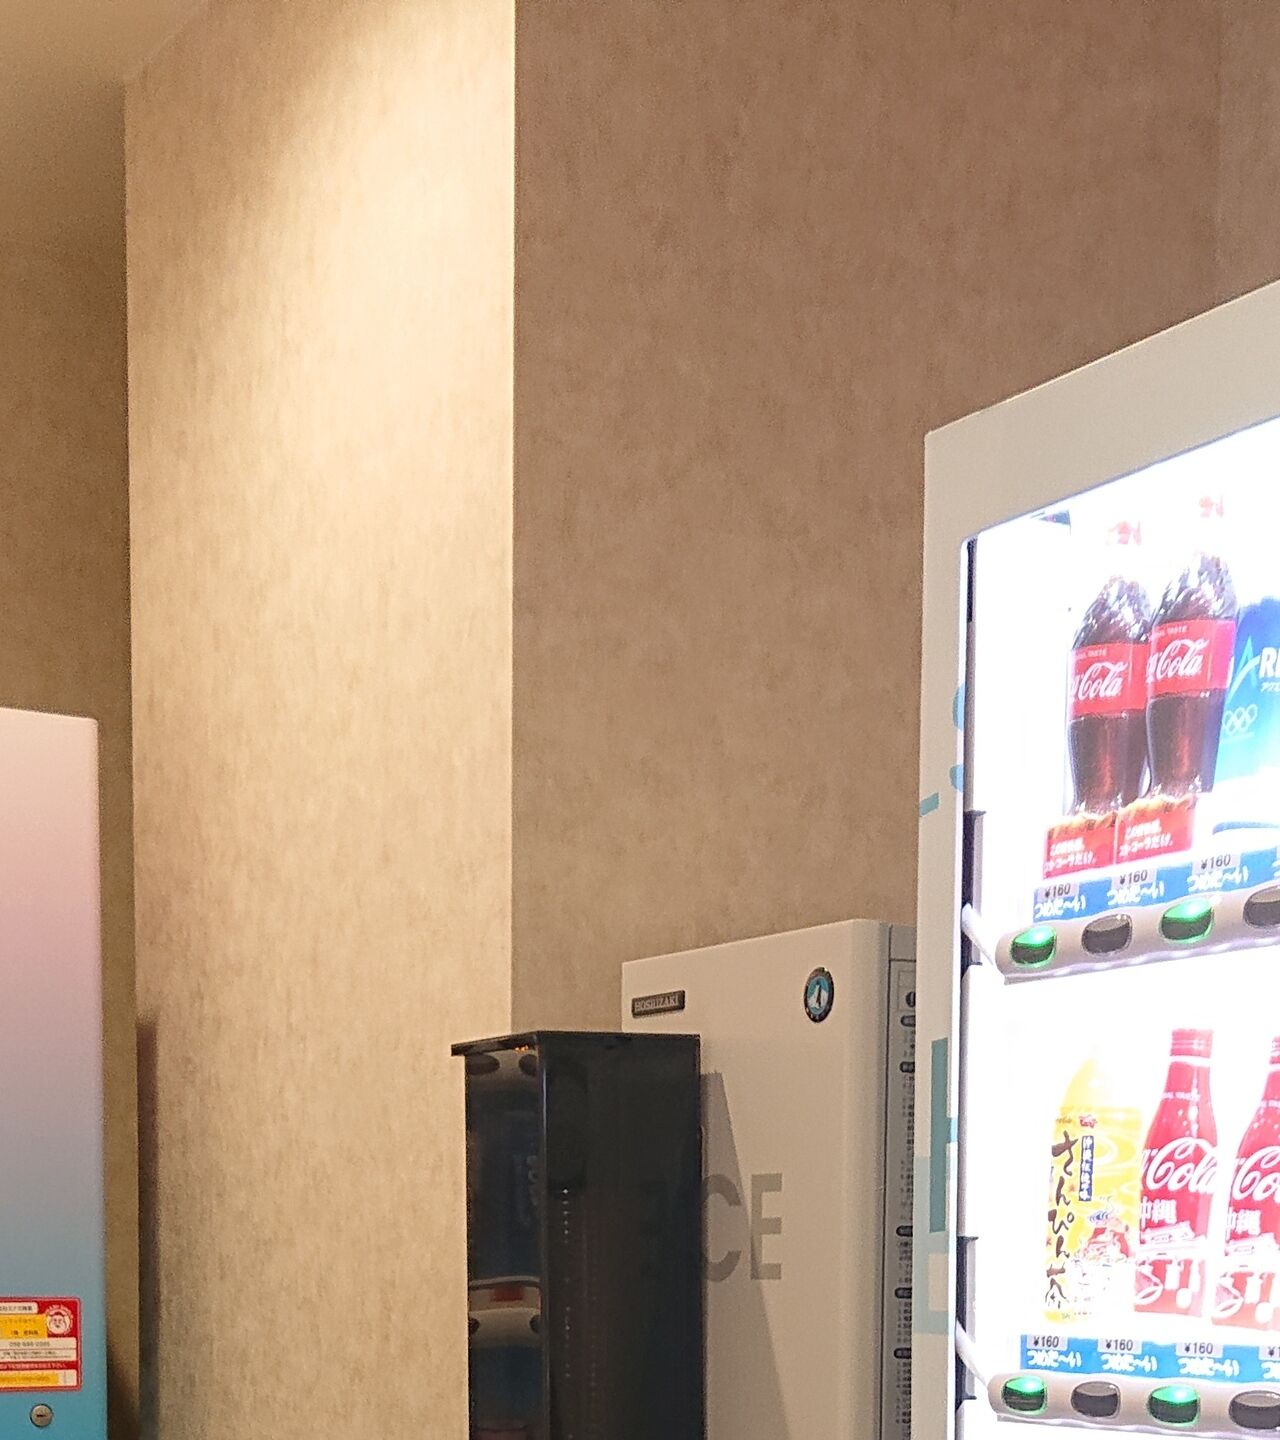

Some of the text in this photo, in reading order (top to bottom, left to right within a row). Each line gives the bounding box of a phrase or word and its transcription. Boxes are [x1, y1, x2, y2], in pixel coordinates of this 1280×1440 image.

[1200, 854, 1231, 871] ¥160
[1119, 869, 1148, 885] ¥160
[1045, 883, 1072, 898] ¥160
[633, 995, 680, 1013] HOSHIZAKI
[1045, 1129, 1079, 1310] さんぴん茶
[1033, 1335, 1061, 1349] ¥160
[1105, 1338, 1134, 1352] ¥160
[1183, 1341, 1214, 1356] ¥160
